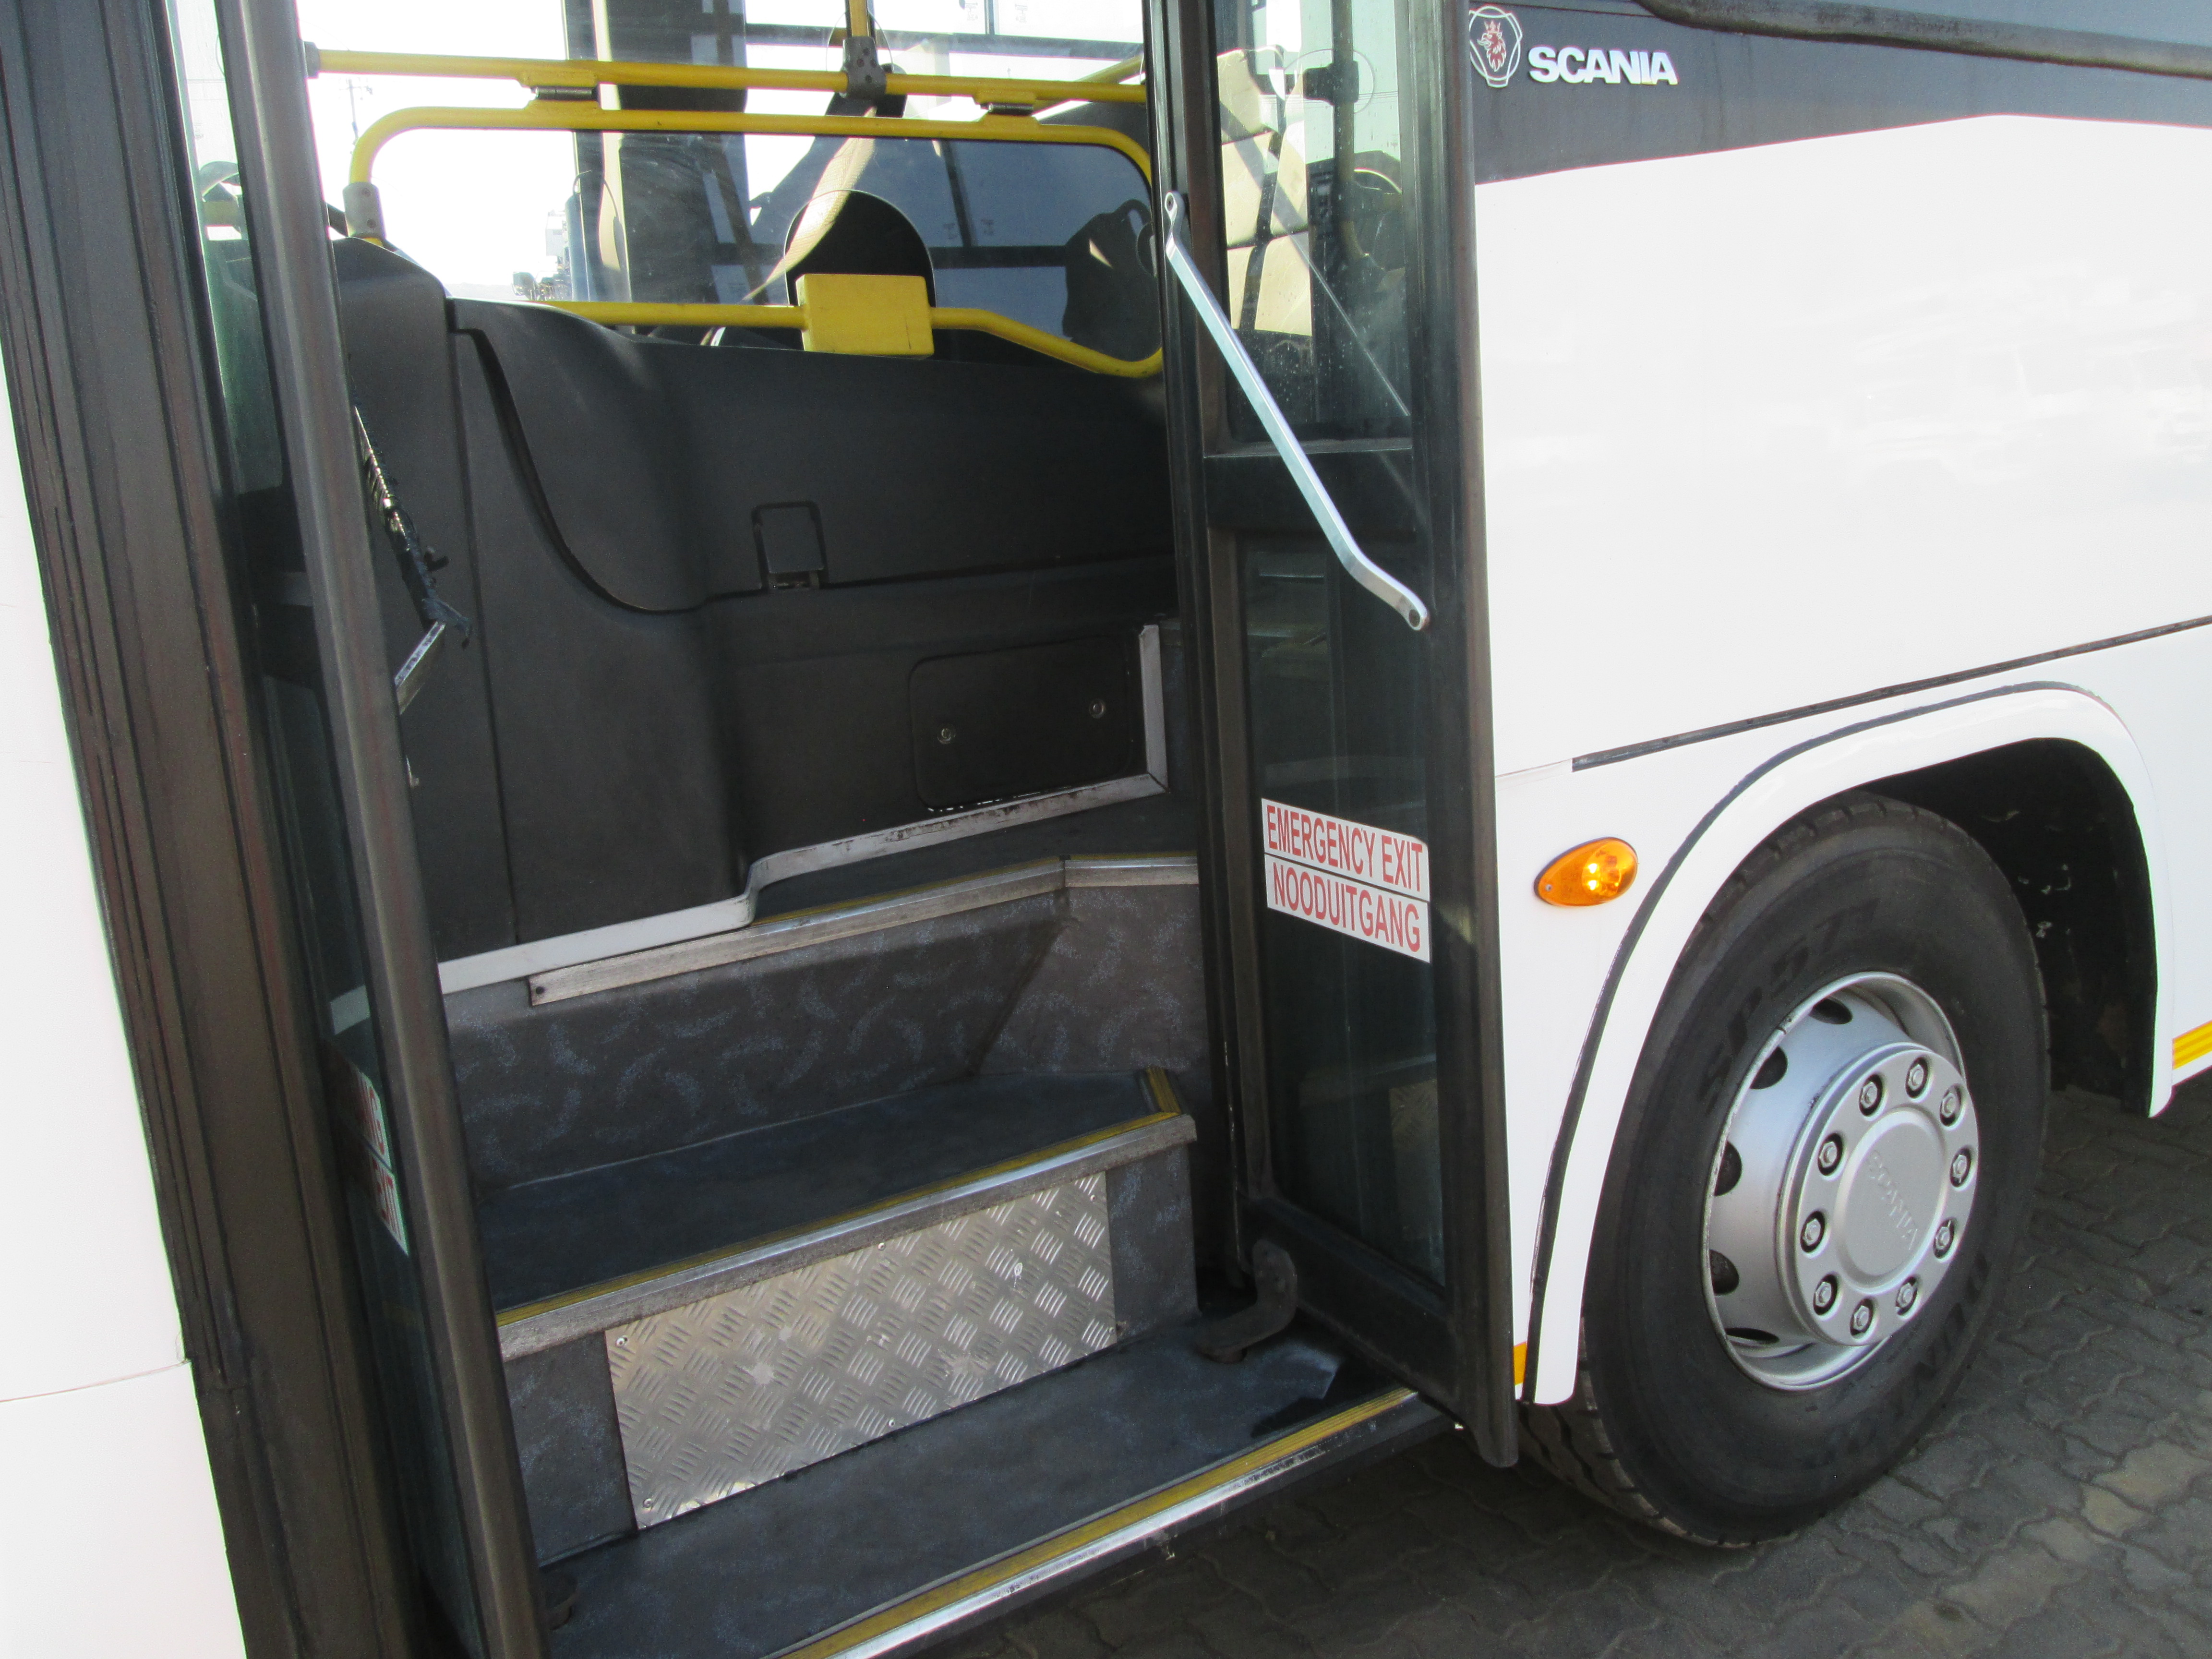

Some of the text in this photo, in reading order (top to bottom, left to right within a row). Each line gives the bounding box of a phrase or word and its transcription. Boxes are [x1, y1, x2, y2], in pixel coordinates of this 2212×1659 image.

[1528, 46, 1678, 85] SCANIA
[1267, 805, 1423, 892] EMERGENCY EXIT
[1273, 862, 1420, 952] NOODUITGANG
